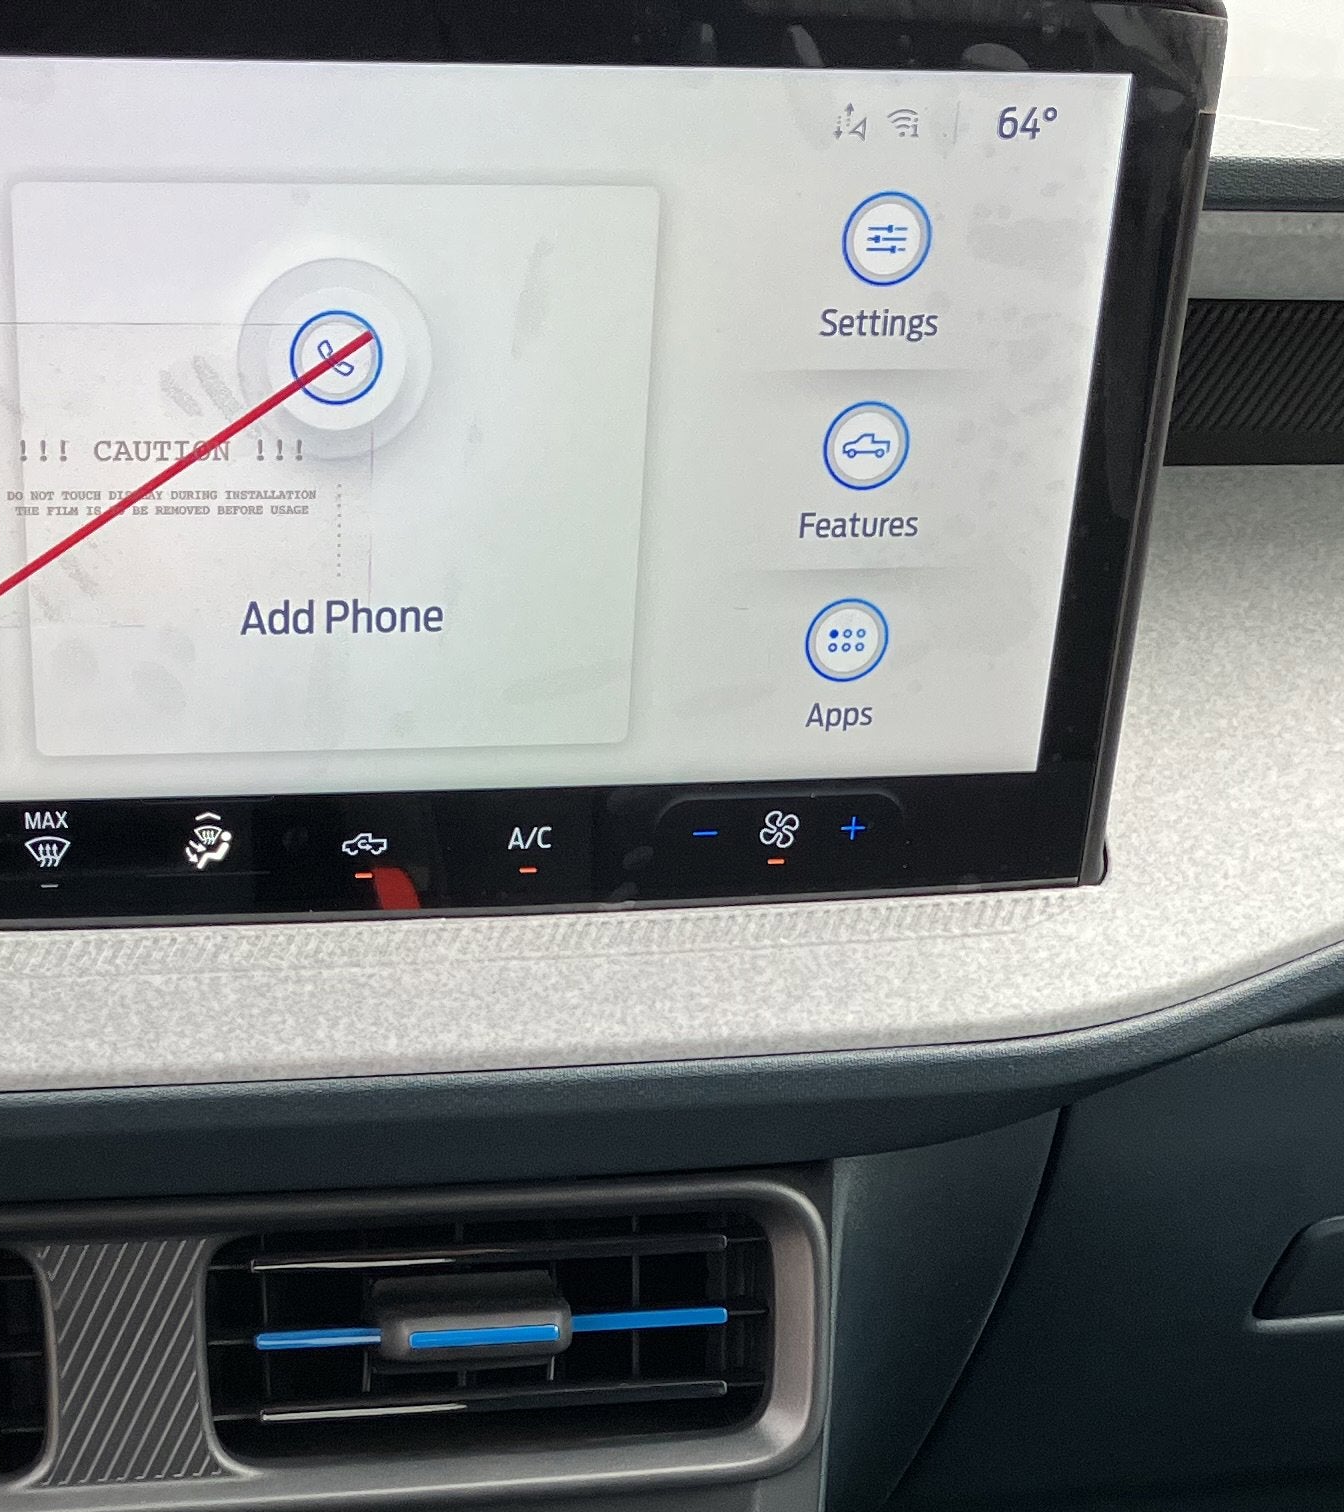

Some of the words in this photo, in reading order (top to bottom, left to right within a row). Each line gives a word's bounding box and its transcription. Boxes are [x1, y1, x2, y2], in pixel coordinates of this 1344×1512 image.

[997, 106, 1059, 141] 64°
[819, 308, 939, 343] Settings
[93, 440, 231, 462] CAUTION
[7, 490, 23, 501] DO
[30, 490, 55, 501] NOT
[61, 490, 102, 501] TOUCH
[170, 489, 218, 500] DURING
[225, 489, 317, 500] INSTALLATION
[15, 506, 39, 517] THE
[47, 505, 79, 516] FILM
[86, 505, 102, 516] IS
[133, 505, 149, 516] BE
[156, 505, 211, 516] REMOVED
[217, 505, 264, 516] BEFORE
[270, 504, 309, 515] USAGE
[799, 511, 919, 539] Features
[240, 600, 315, 635] Add
[325, 599, 445, 634] Phone
[805, 702, 873, 732] Apps
[24, 810, 70, 830] MAX
[507, 825, 553, 850] A/C
